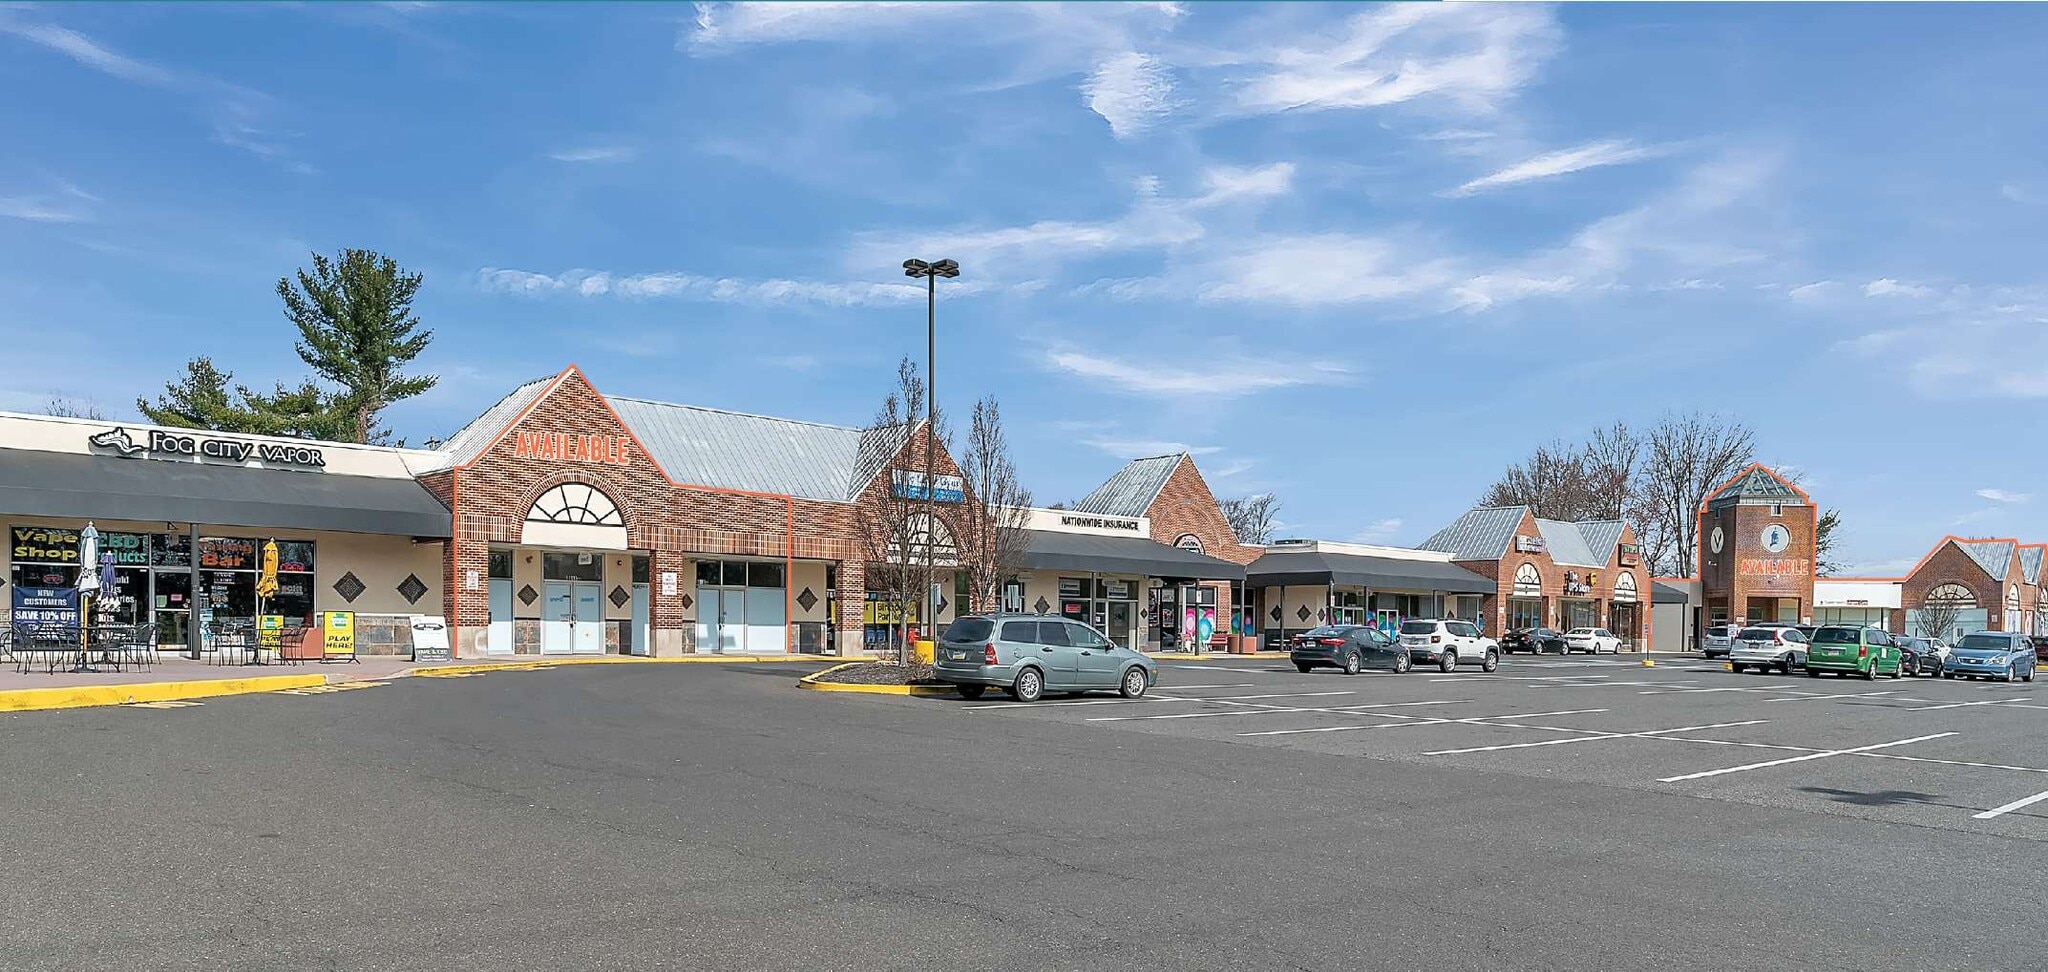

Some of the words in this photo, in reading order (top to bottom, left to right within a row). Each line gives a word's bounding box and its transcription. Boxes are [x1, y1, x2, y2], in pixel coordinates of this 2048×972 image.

[151, 431, 194, 454] FOG
[203, 440, 251, 460] CITY
[260, 446, 325, 465] VAPOR
[1061, 516, 1102, 528] NATIONWIDE
[1103, 520, 1139, 530] INSURANCE
[14, 530, 78, 545] Vape
[14, 546, 78, 561] Shop
[202, 553, 244, 567] Bar
[37, 589, 54, 597] NEW
[24, 598, 67, 606] CUSTOMERS
[15, 610, 39, 620] SAVE
[40, 610, 59, 621] 10%
[60, 611, 76, 621] OFF
